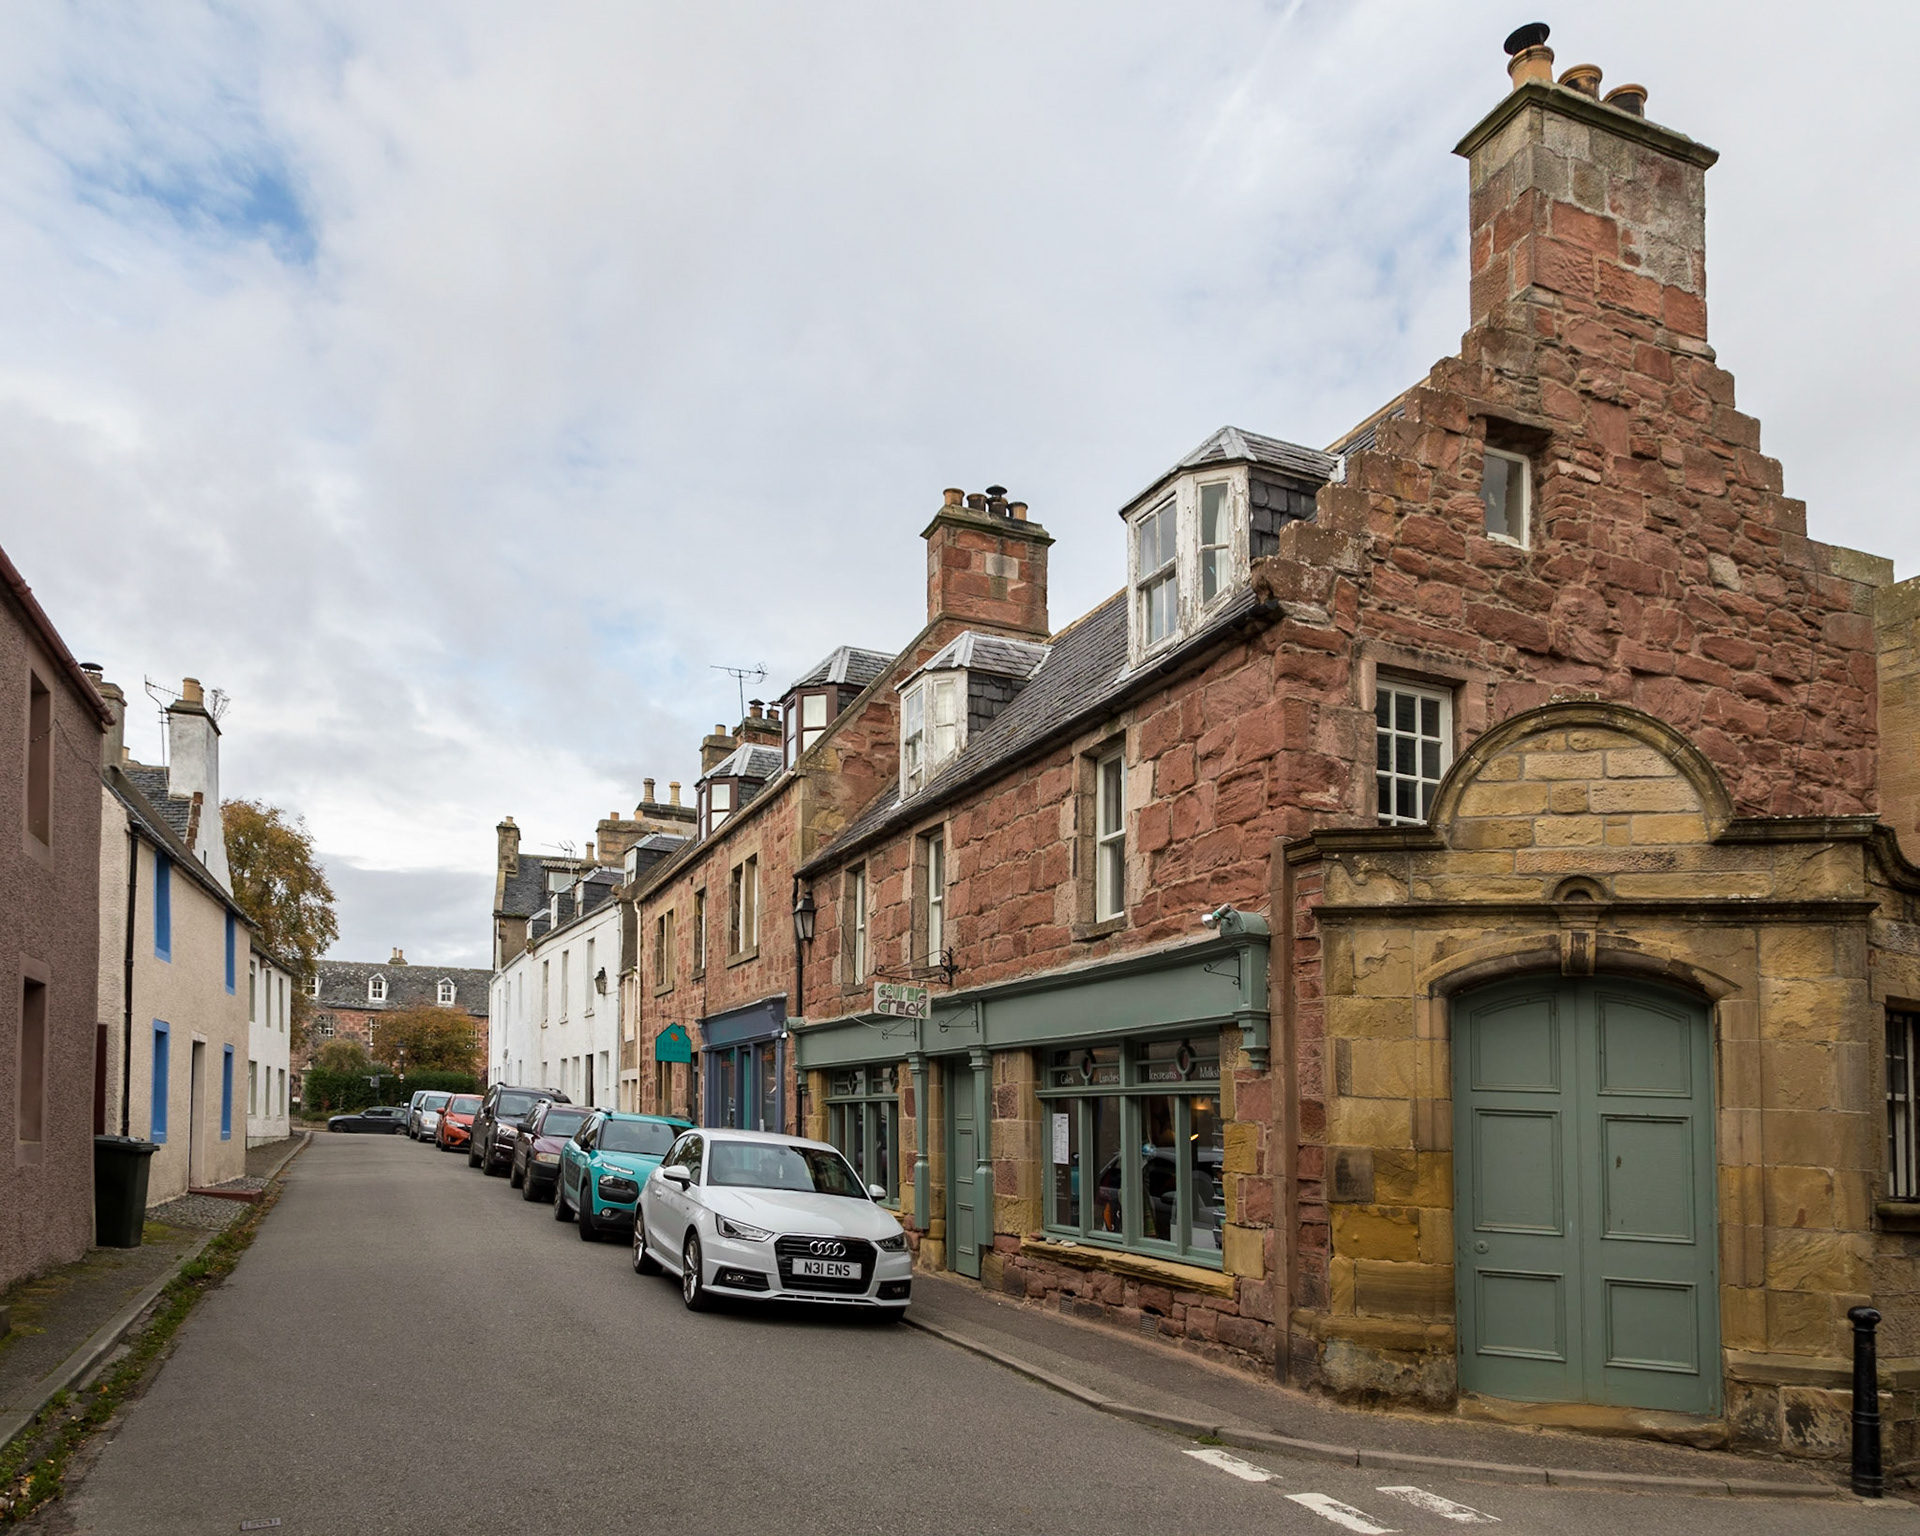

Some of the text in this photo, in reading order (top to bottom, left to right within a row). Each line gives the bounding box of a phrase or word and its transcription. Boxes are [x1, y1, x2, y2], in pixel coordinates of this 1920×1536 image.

[1199, 1066, 1220, 1079] Milksh
[804, 1261, 850, 1277] N31 ENS
